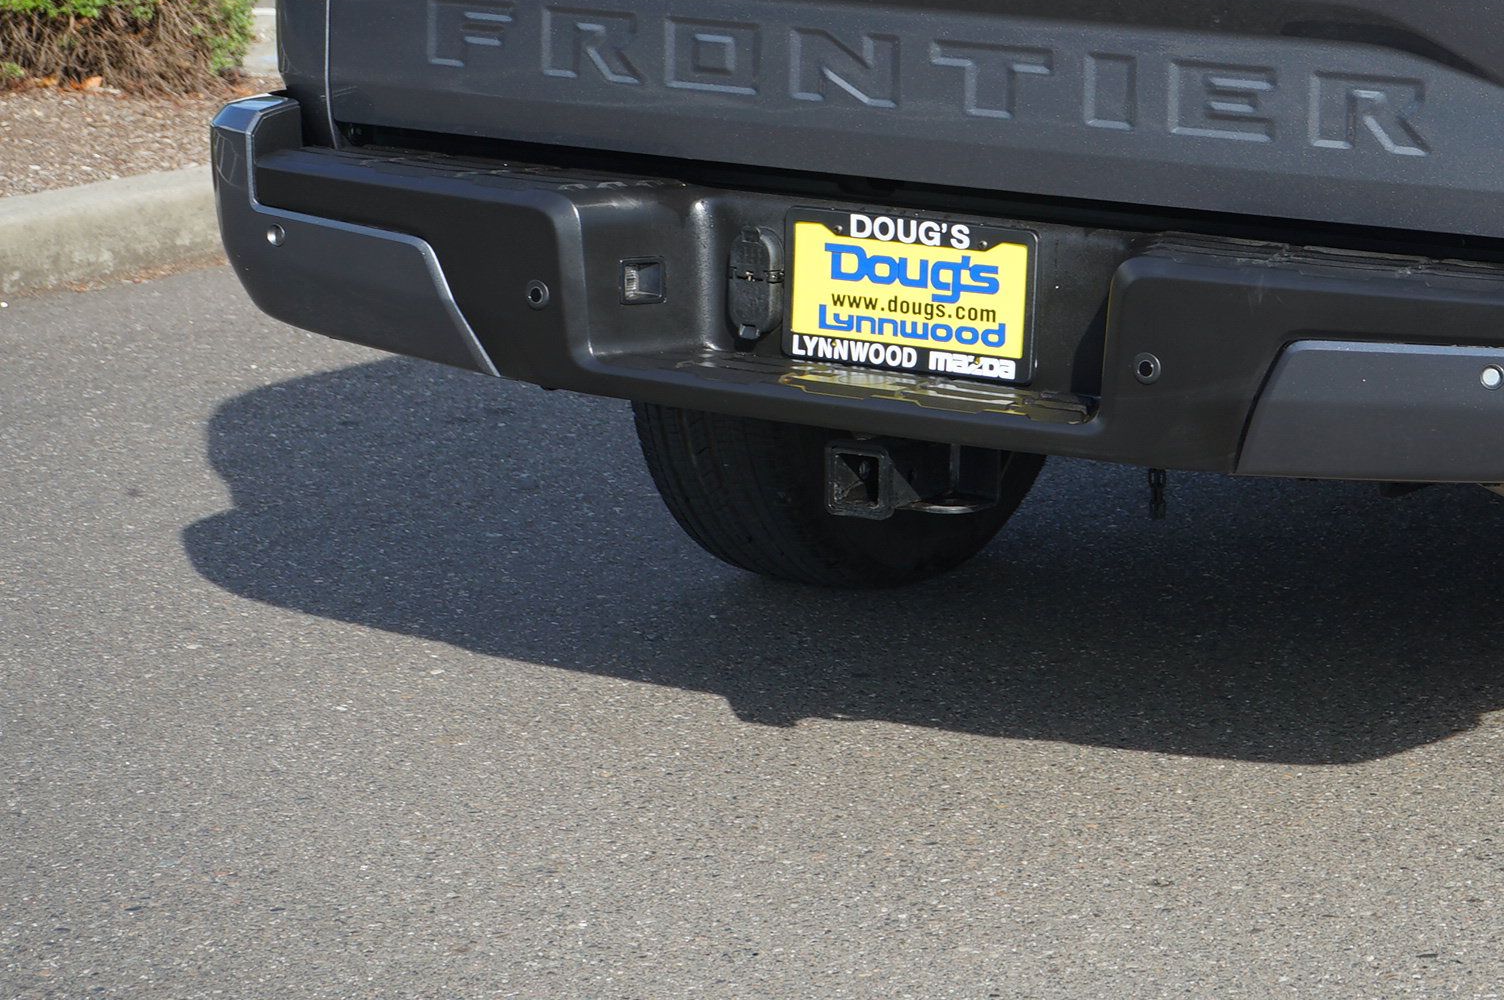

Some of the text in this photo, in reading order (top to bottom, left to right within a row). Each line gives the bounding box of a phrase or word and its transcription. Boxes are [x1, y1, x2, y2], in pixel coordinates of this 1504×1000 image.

[850, 213, 970, 249] DOUG'S
[825, 243, 999, 303] Doug's
[831, 293, 996, 322] www.dougs.com
[818, 304, 1006, 348] Lynnwood
[791, 334, 917, 368] LYNNWOOD
